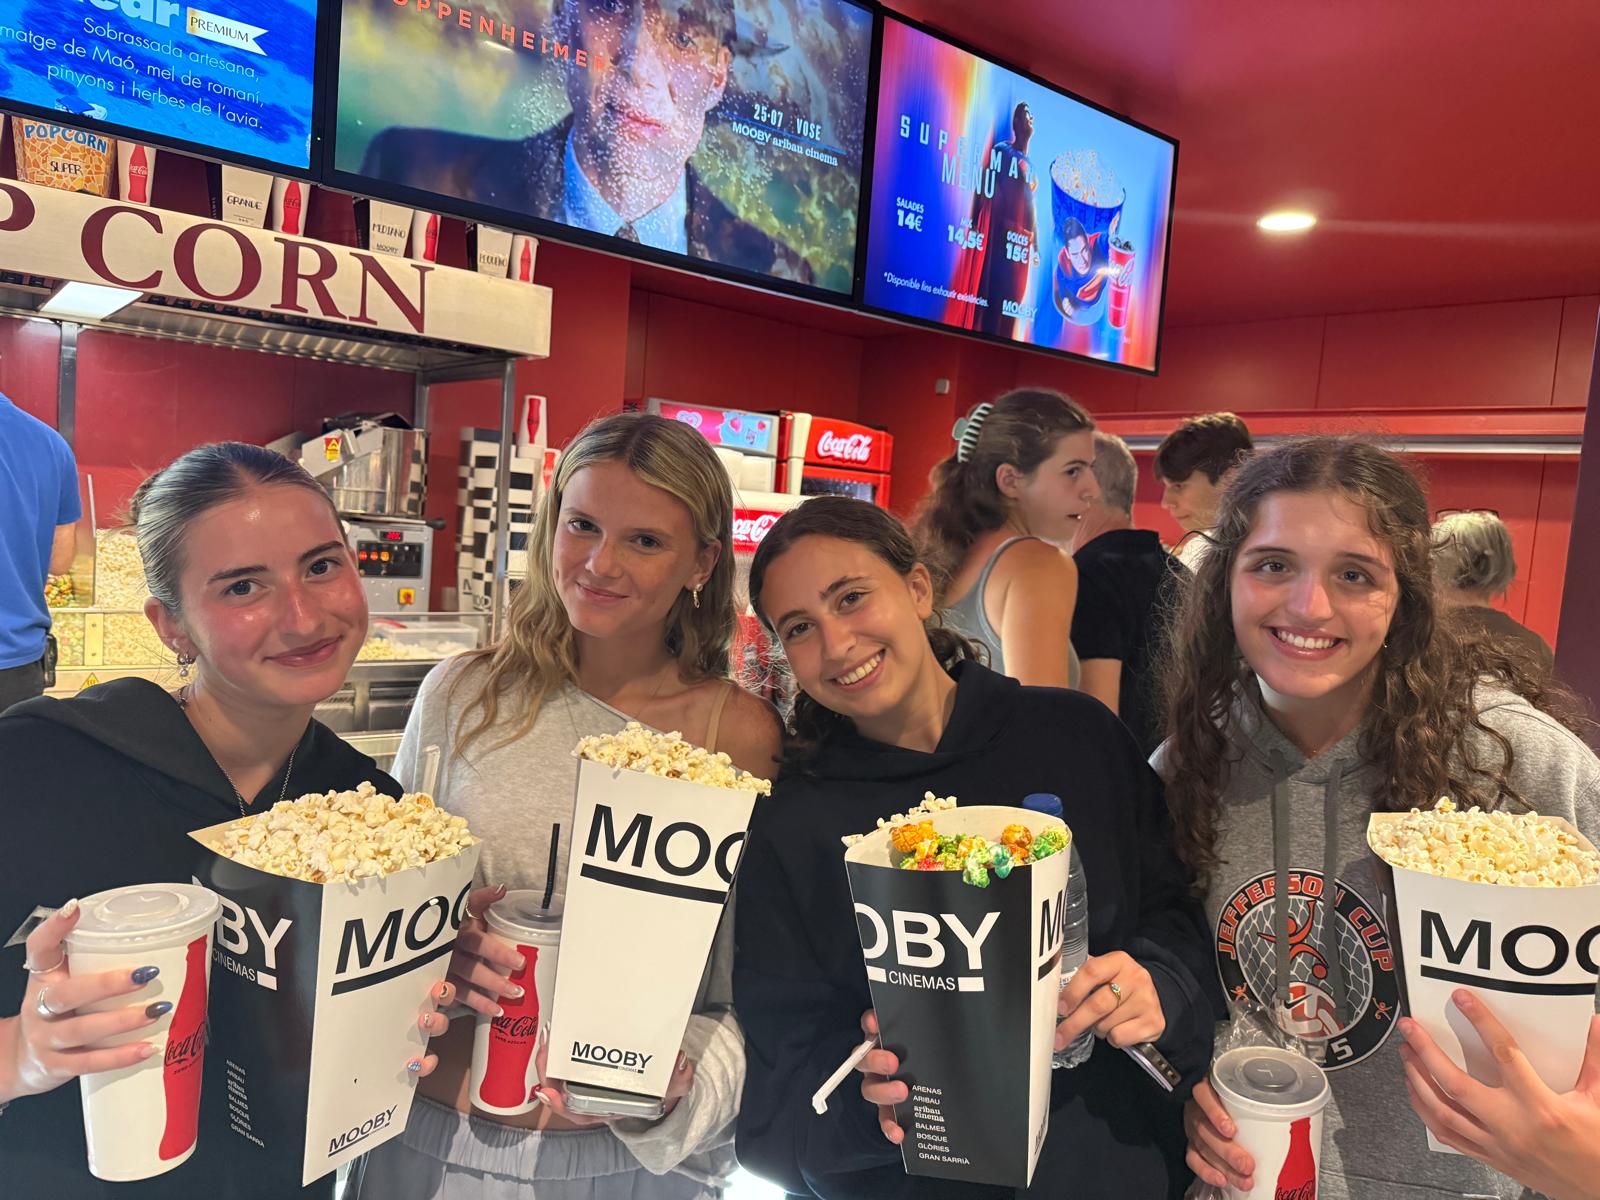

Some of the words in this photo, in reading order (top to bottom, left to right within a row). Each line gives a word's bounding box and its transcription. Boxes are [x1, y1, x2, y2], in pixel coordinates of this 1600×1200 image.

[190, 16, 249, 43] PREMIUM
[83, 17, 183, 58] Sobrassada
[189, 52, 260, 82] artesana,
[63, 38, 87, 57] de
[92, 46, 140, 74] Maó,
[147, 65, 175, 82] mel
[181, 70, 202, 88] de
[208, 82, 264, 108] romaní,
[47, 64, 114, 93] pinyons
[121, 76, 126, 94] i
[132, 81, 186, 109] herbes
[192, 98, 212, 115] de
[218, 103, 263, 129] l'avia.
[24, 124, 107, 154] POPCORN
[797, 118, 822, 141] VOSE
[732, 122, 772, 143] MOOBY
[773, 138, 804, 154] aribau
[805, 149, 838, 166] cinema
[900, 114, 1035, 185] SUPERMAN
[50, 160, 84, 176] SUPER
[227, 195, 262, 211] GRANDE
[896, 197, 925, 213] SALADES
[373, 223, 406, 239] MEDIANO
[897, 209, 923, 232] 14€
[948, 225, 985, 251] 14,5€
[1006, 243, 1029, 264] 15€
[81, 205, 434, 333] CORN
[817, 430, 873, 461] Coca-Cola
[215, 892, 293, 969] BY
[1348, 906, 1394, 972] CUP
[213, 947, 256, 982] CINEMAS
[888, 970, 956, 991] CINEMAS
[572, 1041, 653, 1069] MOOBY
[912, 1084, 942, 1095] ARENAS
[913, 1095, 940, 1105] ARIBAU
[914, 1105, 940, 1115] aribau
[914, 1112, 945, 1122] cinema
[329, 1104, 398, 1153] MOOBY
[915, 1122, 946, 1132] BALMES
[916, 1133, 948, 1142] BOSQUE
[919, 1152, 940, 1161] GRAN
